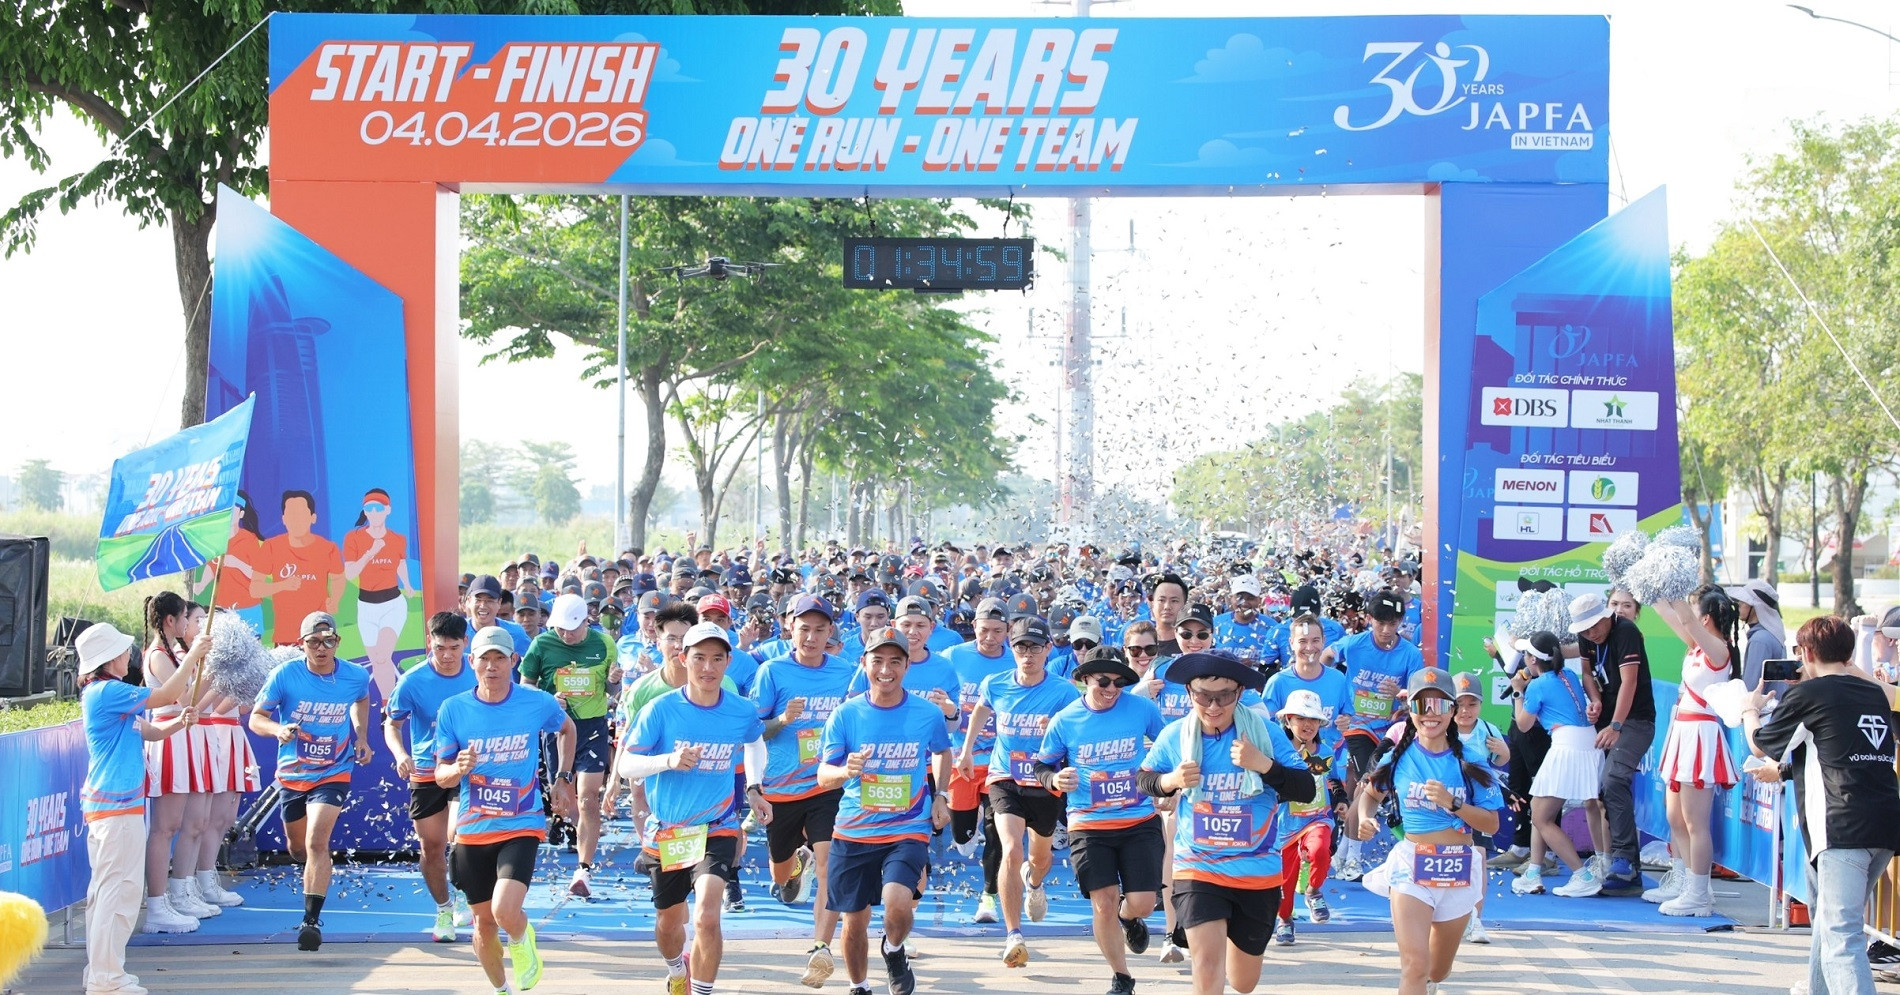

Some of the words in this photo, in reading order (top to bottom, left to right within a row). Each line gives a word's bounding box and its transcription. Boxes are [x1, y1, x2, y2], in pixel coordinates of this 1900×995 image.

[310, 44, 470, 102] START
[494, 46, 656, 103] FINISH
[760, 27, 868, 115] 30
[873, 28, 1119, 115] YEARS
[1462, 84, 1504, 94] YEARS
[1461, 102, 1593, 131] JAPFA
[360, 110, 645, 146] 04.04.2026
[717, 117, 805, 171] ONE
[803, 118, 902, 172] RUN
[922, 118, 1012, 172] ONE
[1013, 118, 1139, 172] TEAM
[1515, 136, 1527, 147] IN
[1532, 136, 1590, 147] VIETNAM
[1577, 353, 1639, 368] JAPFA
[1515, 370, 1536, 384] ĐỐI
[1538, 372, 1559, 385] TÁC
[1560, 373, 1594, 386] CHÍNH
[1595, 374, 1627, 386] THỨC
[1514, 398, 1557, 417] DBS
[1520, 450, 1541, 464] ĐỐI
[1543, 452, 1564, 465] TÁC
[1566, 453, 1590, 466] TIÊU
[1591, 452, 1616, 467] BIỂU
[1502, 480, 1557, 492] MENON
[1519, 564, 1539, 576] ĐỐI
[1541, 565, 1563, 577] TÁC
[563, 677, 590, 686] 5590
[296, 700, 313, 714] 30
[312, 702, 348, 716] YEARS
[1360, 699, 1386, 711] 5630
[1019, 727, 1034, 737] ONE
[303, 742, 332, 755] 1055
[485, 733, 530, 753] YEARS
[877, 742, 920, 759] YEARS
[1078, 743, 1093, 758] 30
[1095, 737, 1136, 756] YEARS
[493, 751, 511, 763] ONE
[510, 748, 531, 761] TEAM
[698, 759, 716, 770] ONE
[884, 758, 903, 770] ONE
[901, 758, 920, 769] TEAM
[868, 786, 903, 799] 5633
[1099, 780, 1131, 795] 1054
[477, 787, 511, 804] 1045
[1219, 791, 1237, 802] ONE
[1202, 817, 1242, 832] 1057
[1424, 858, 1463, 872] 2125
